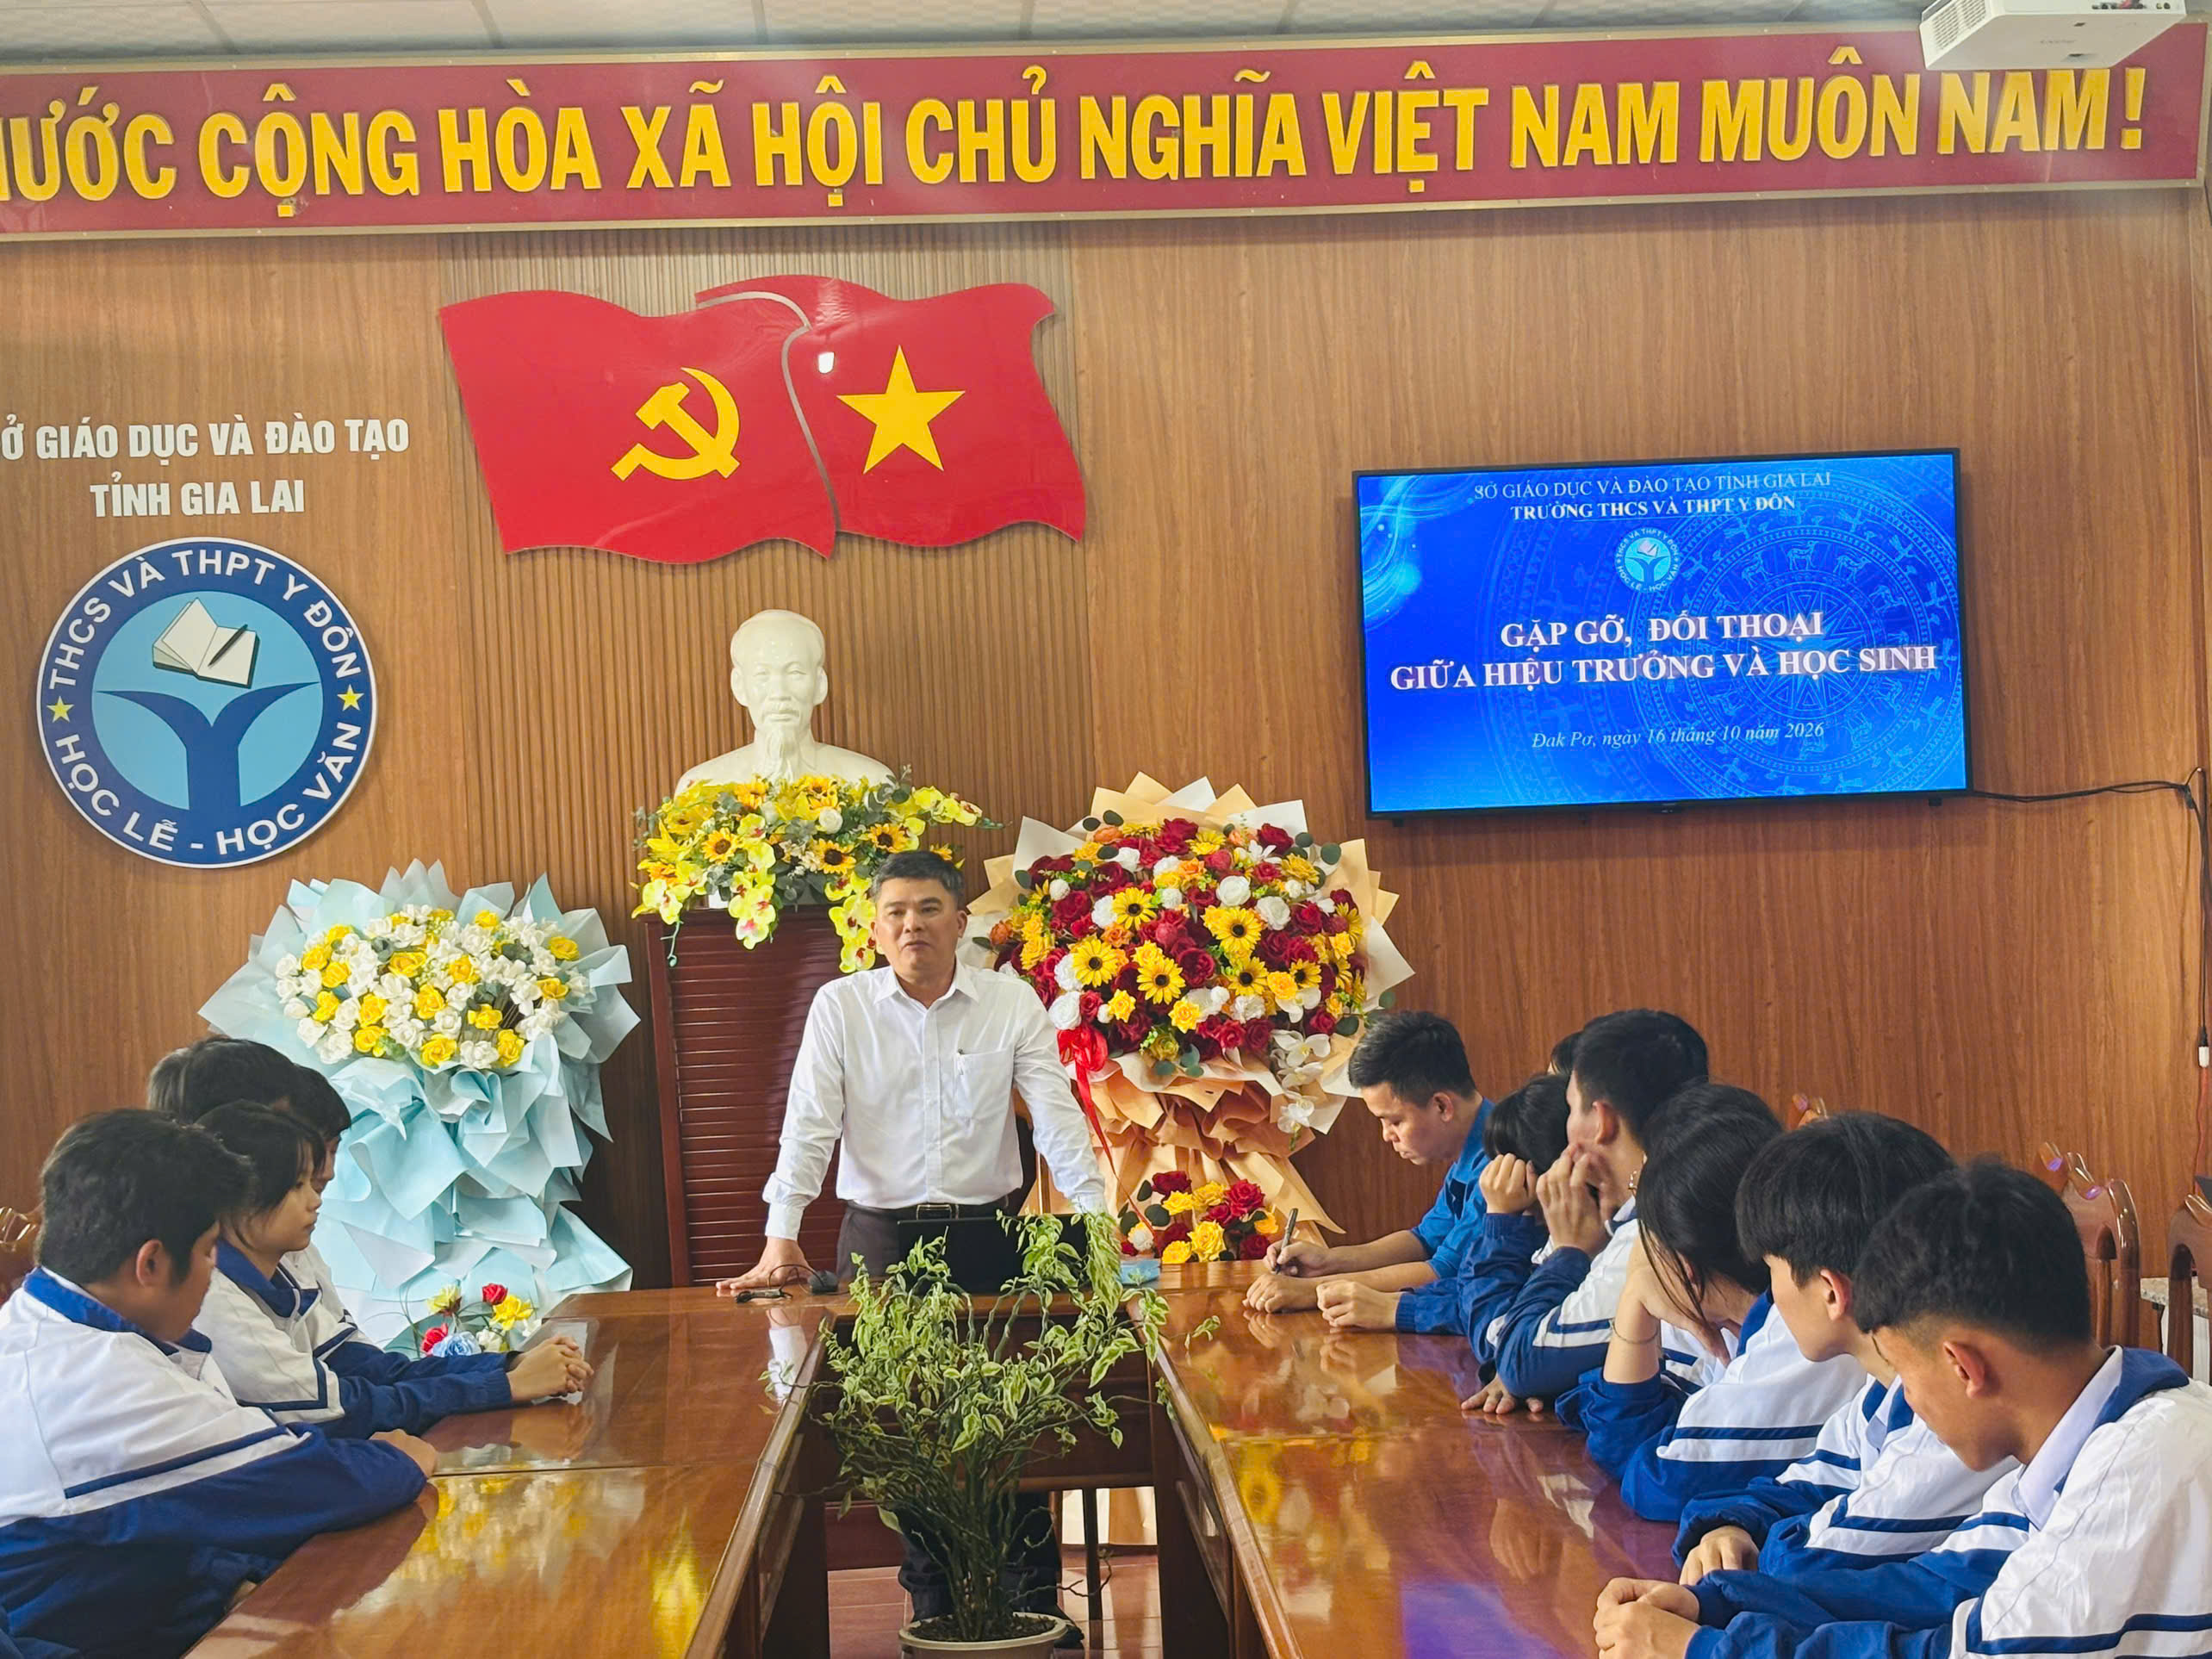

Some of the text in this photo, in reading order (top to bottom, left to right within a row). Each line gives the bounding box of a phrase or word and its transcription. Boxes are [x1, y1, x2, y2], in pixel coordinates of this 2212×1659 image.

[0, 86, 177, 202] ƯỚC
[199, 84, 419, 218] CỘNG
[438, 78, 602, 194] HÒA
[621, 79, 733, 190] XÃ
[752, 76, 883, 207] HỘI
[906, 65, 1058, 183] CHỦ
[1079, 68, 1308, 182] NGHĨA
[1322, 60, 1489, 193] VIỆT
[1509, 81, 1681, 169] NAM
[1700, 46, 1922, 163] MUÔN
[35, 416, 119, 459] GIÁO
[128, 423, 199, 466] DỤC
[208, 413, 254, 456] VÀ
[264, 413, 336, 454] ĐÀO
[345, 419, 409, 461] TẠO
[90, 471, 305, 518] TỈNH GIA LAI
[1502, 480, 1549, 498] GIÁO
[1554, 482, 1592, 499] DỤC
[1597, 476, 1623, 495] VÀ
[1628, 475, 1668, 494] ĐÀO
[1672, 476, 1711, 494] TẠO
[1763, 473, 1797, 489] GIA
[1801, 471, 1831, 488] LAI
[1510, 492, 1796, 521] TRƯỜNG THCS VÀ THPT Y ĐÔN
[49, 549, 362, 689] THCS VÀ THPT Y ĐÔN
[1500, 610, 1824, 653] GẶP GỠ, ĐỐI THOẠI
[1390, 645, 1937, 692] GIỮA HIỆU TRƯỞNG VÀ HỌC SINH
[1532, 731, 1565, 749] Đak
[1601, 729, 1642, 749] ngày
[1647, 729, 1666, 744] 16
[1670, 727, 1717, 745] tháng
[1723, 724, 1741, 741] 10
[1745, 723, 1780, 740] năm
[1784, 722, 1825, 738] 2026
[55, 734, 120, 817] HỌC
[123, 811, 178, 852] LỄ
[216, 804, 305, 854] HỌC
[302, 722, 362, 800] VĂN
